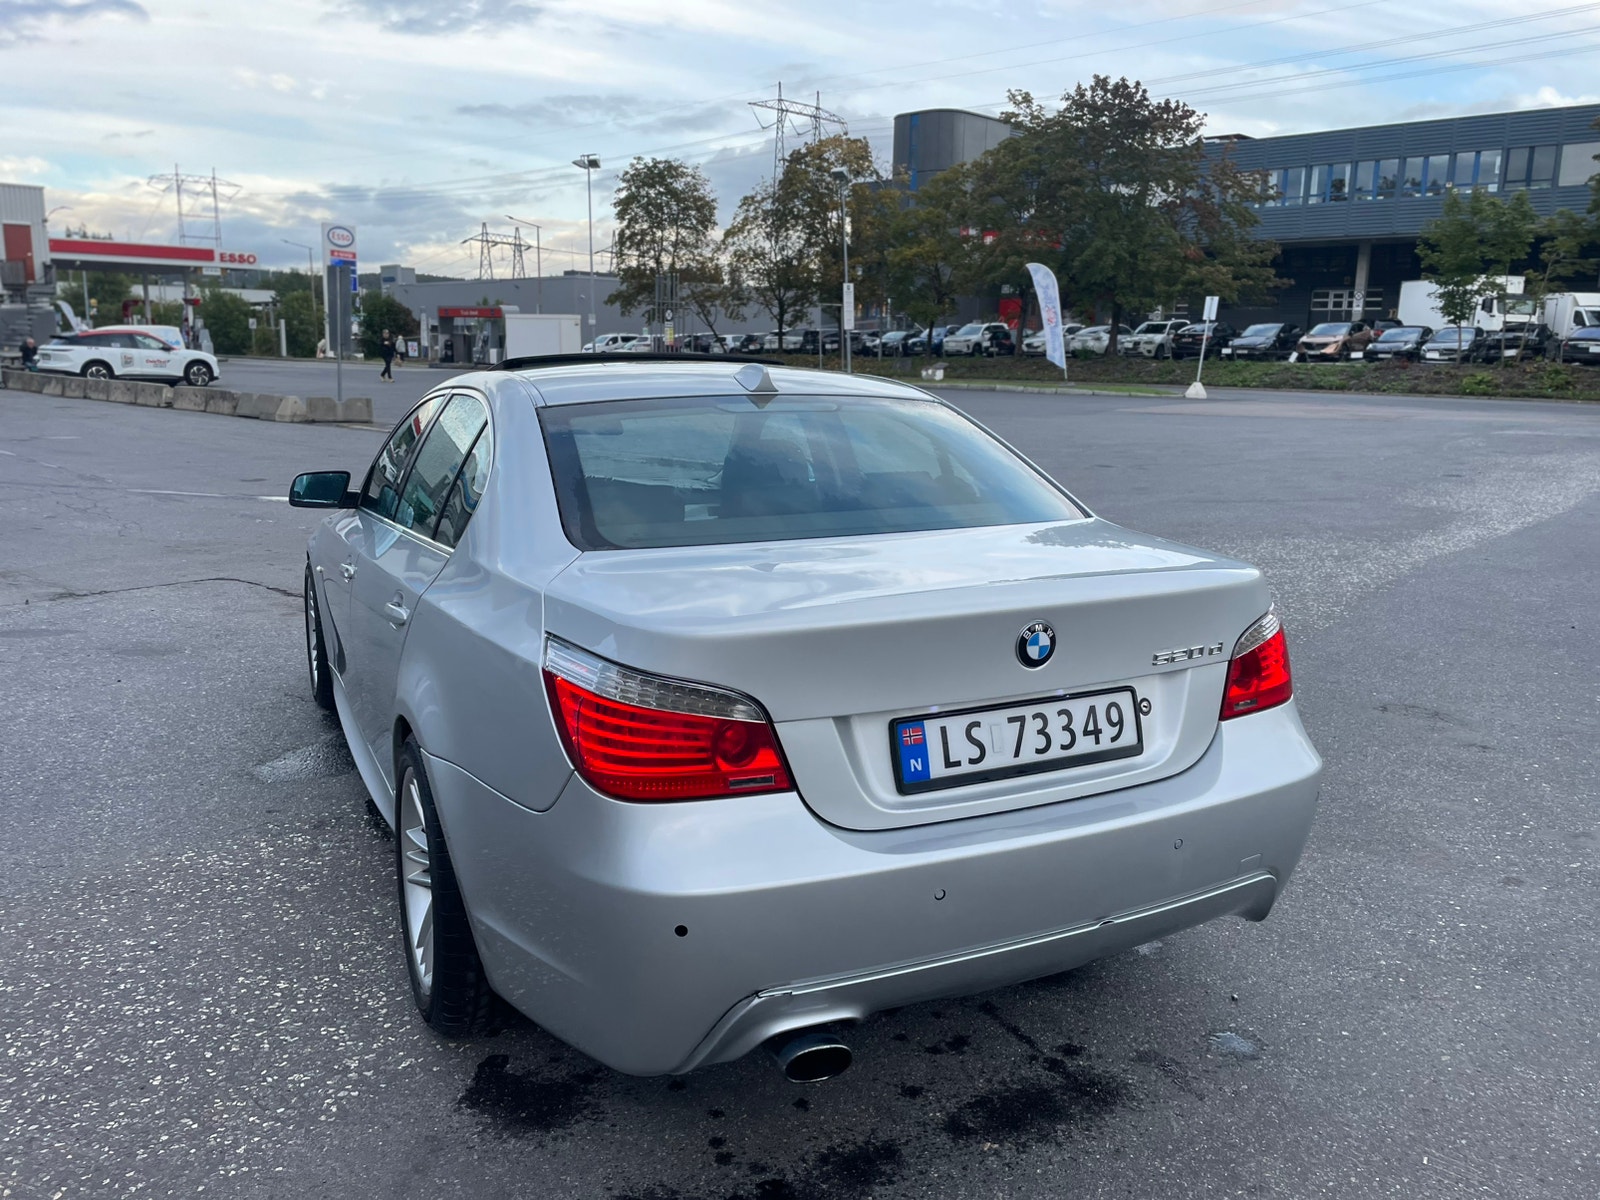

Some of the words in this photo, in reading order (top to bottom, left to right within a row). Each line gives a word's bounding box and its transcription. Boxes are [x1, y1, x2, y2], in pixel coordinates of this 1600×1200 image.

[219, 252, 257, 265] ESSO
[1023, 624, 1054, 640] BMW
[939, 720, 987, 770] LS
[1007, 701, 1125, 758] 73349
[910, 758, 922, 772] N
